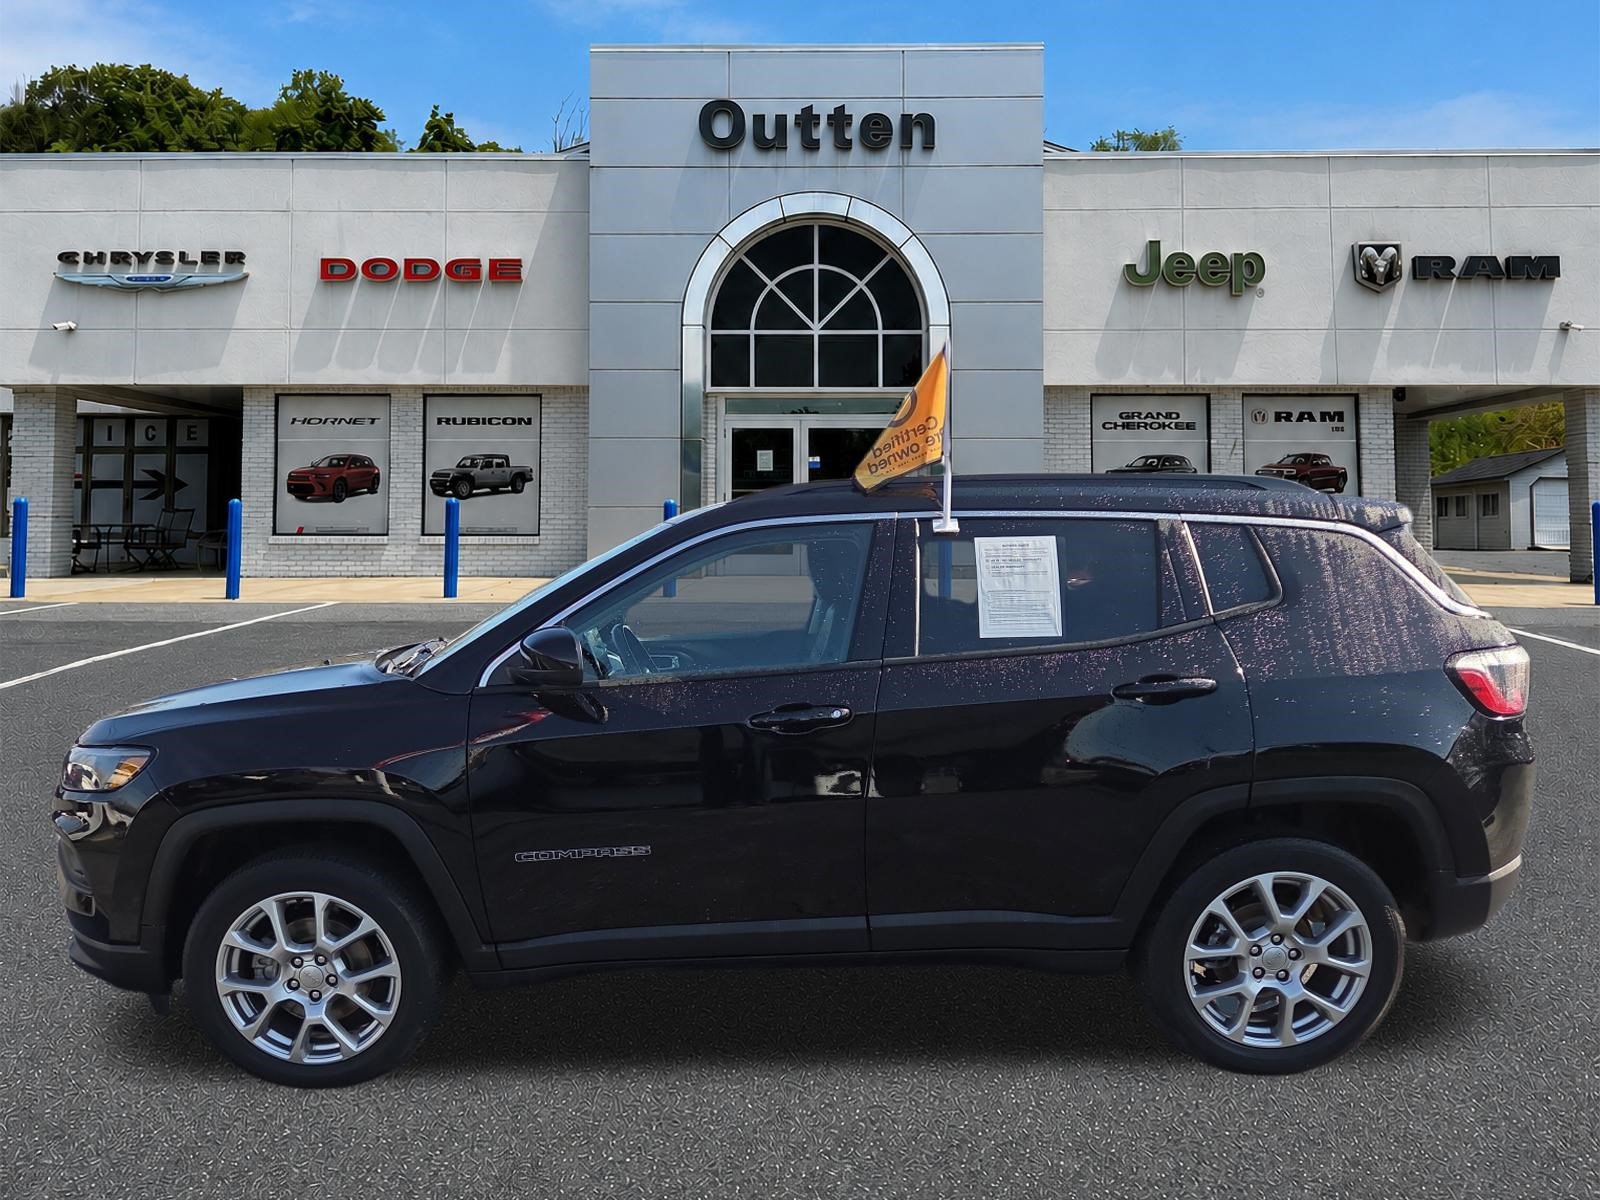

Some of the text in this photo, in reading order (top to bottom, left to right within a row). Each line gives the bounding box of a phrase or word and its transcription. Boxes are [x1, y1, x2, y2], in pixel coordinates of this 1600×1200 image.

[699, 99, 936, 151] Outten
[57, 250, 247, 265] CHRYSLER
[320, 256, 523, 283] DODGE
[1123, 239, 1267, 297] Jeep
[1411, 255, 1562, 280] RAM
[290, 417, 381, 425] HORNET
[436, 416, 533, 426] RUBICON
[1118, 411, 1181, 420] GRAND
[1274, 411, 1345, 423] RAM
[1101, 421, 1197, 431] CHEROKEE
[514, 845, 652, 862] COMPASS
